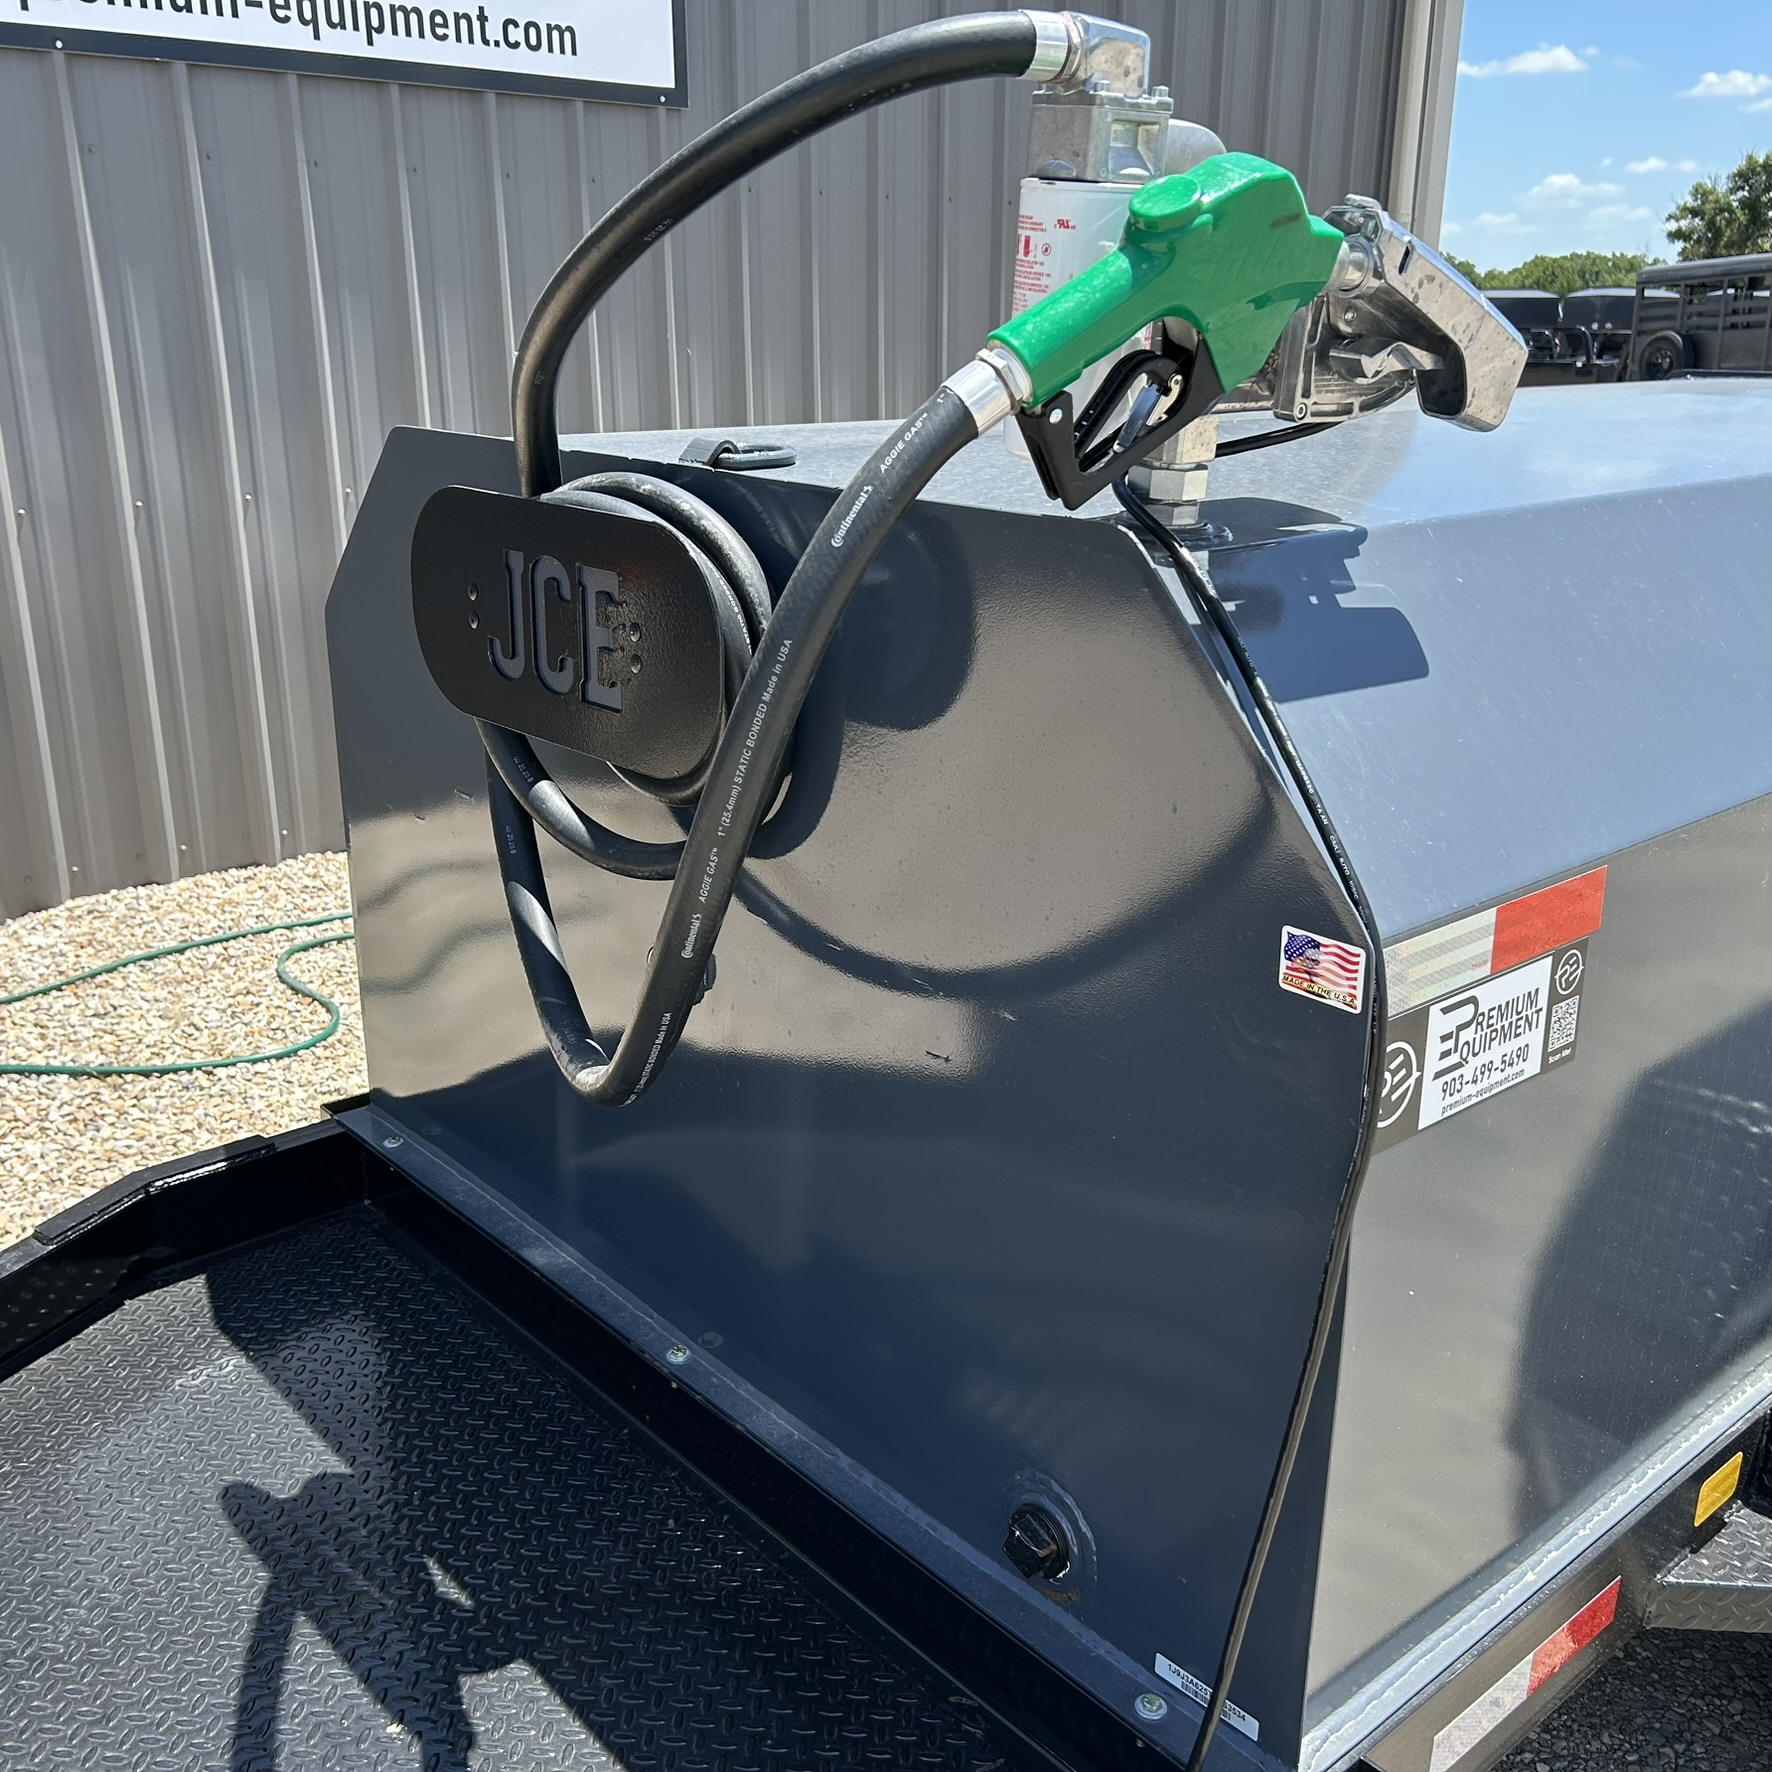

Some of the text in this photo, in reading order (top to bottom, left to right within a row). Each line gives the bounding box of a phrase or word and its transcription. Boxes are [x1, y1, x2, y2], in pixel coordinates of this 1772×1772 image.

[19, 0, 578, 57] -equipment.com
[831, 490, 870, 548] Continental
[879, 439, 906, 474] AGGIE
[486, 548, 626, 714] JCE
[776, 638, 793, 667] USA
[774, 660, 782, 674] in
[762, 676, 778, 703] Made
[745, 702, 768, 748] BONDED
[733, 747, 752, 784] STATIC
[721, 784, 743, 827] (25.4mm)
[699, 873, 713, 903] AGGIE
[681, 917, 702, 959] Continental
[1282, 975, 1305, 987] MADE
[1306, 982, 1315, 991] IN
[1316, 986, 1332, 996] THE
[661, 1012, 672, 1025] USA
[1440, 987, 1540, 1048] PREMIUM
[1432, 1007, 1543, 1081] EQUIPMENT
[1440, 1043, 1530, 1102] 903-499-5490
[1440, 1068, 1525, 1117] premium-equipment.com
